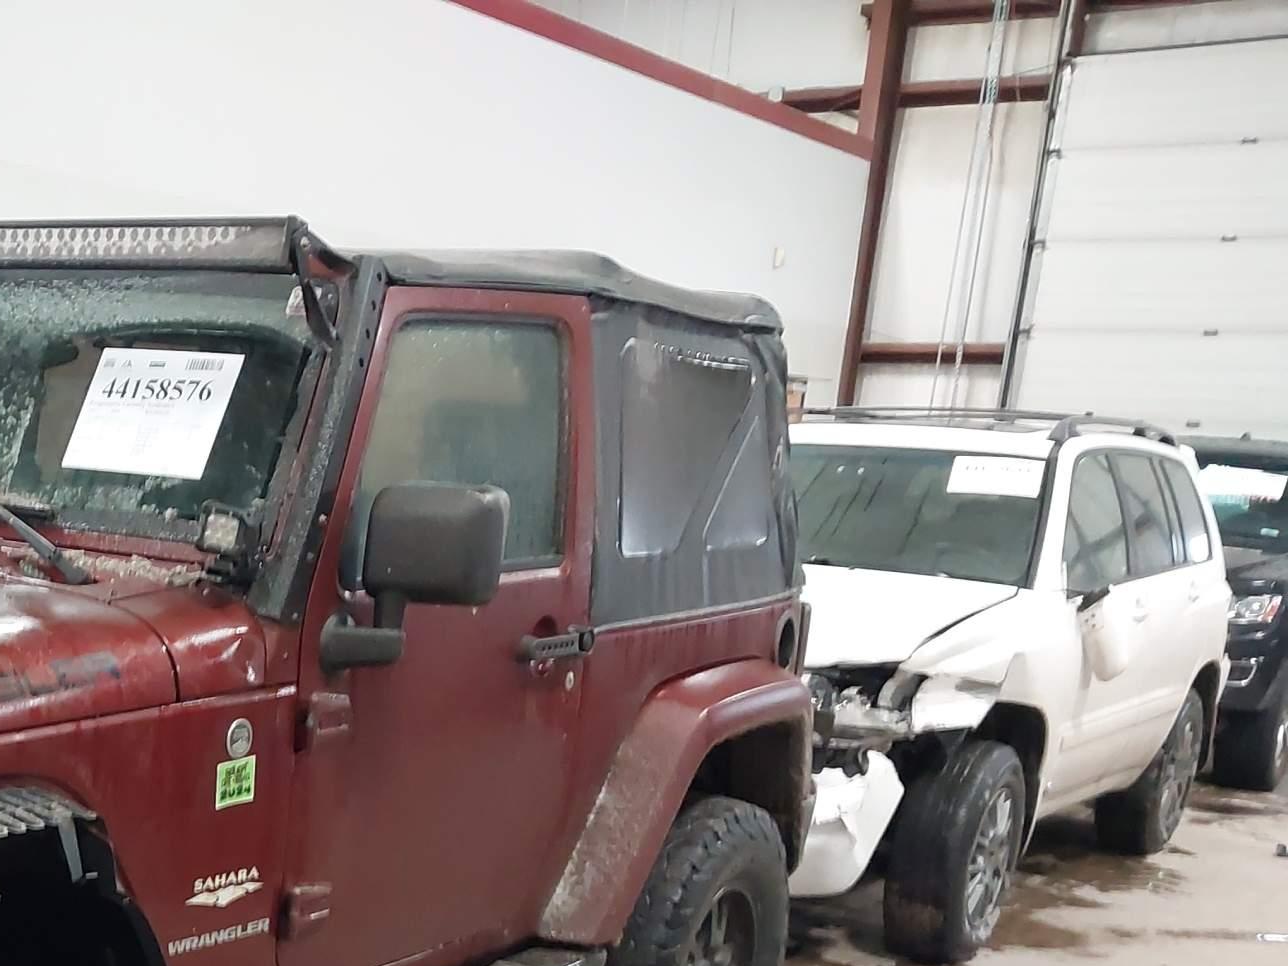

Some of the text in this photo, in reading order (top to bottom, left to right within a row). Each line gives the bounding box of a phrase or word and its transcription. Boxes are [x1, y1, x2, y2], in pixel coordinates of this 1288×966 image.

[102, 377, 215, 401] 44158576
[193, 865, 260, 894] SAHARA
[167, 917, 271, 957] WRANGLER
